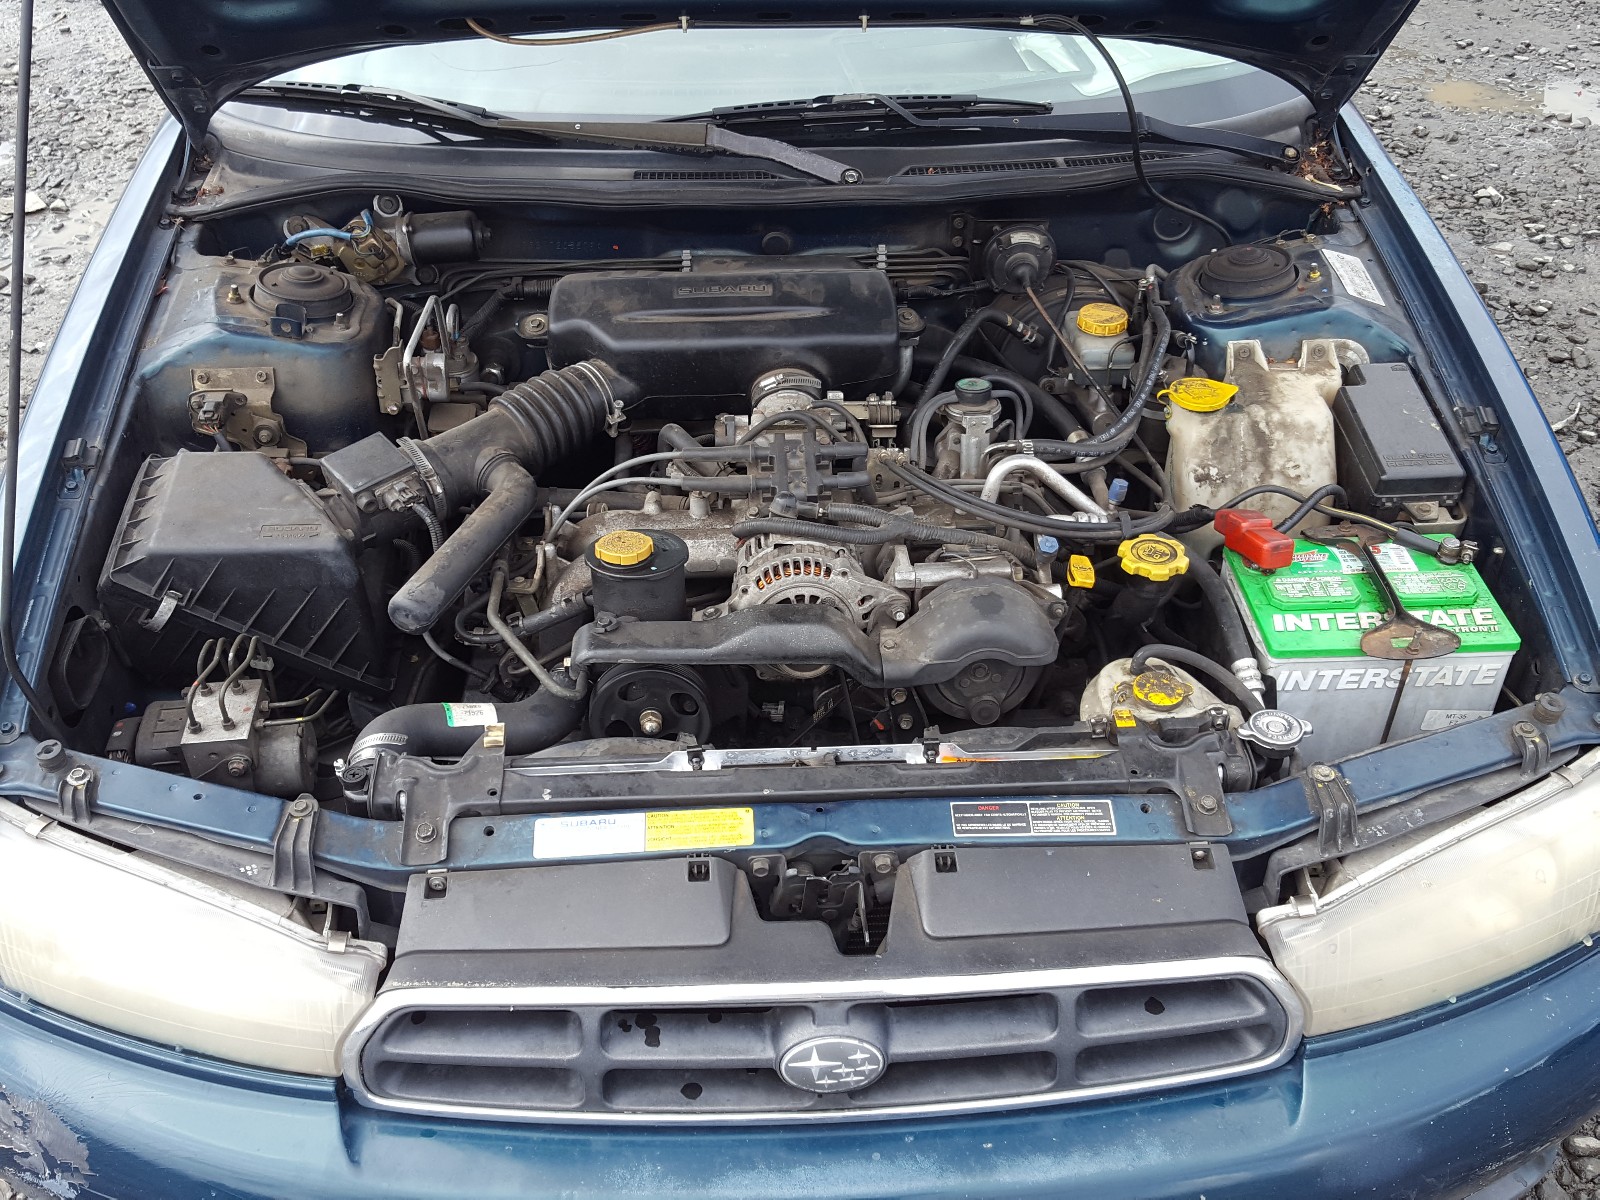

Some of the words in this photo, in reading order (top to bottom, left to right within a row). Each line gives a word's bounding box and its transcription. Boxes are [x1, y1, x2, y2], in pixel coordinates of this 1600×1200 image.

[678, 284, 767, 295] SUBARU
[1272, 608, 1498, 633] INTERTATE
[560, 818, 617, 827] SUBARU
